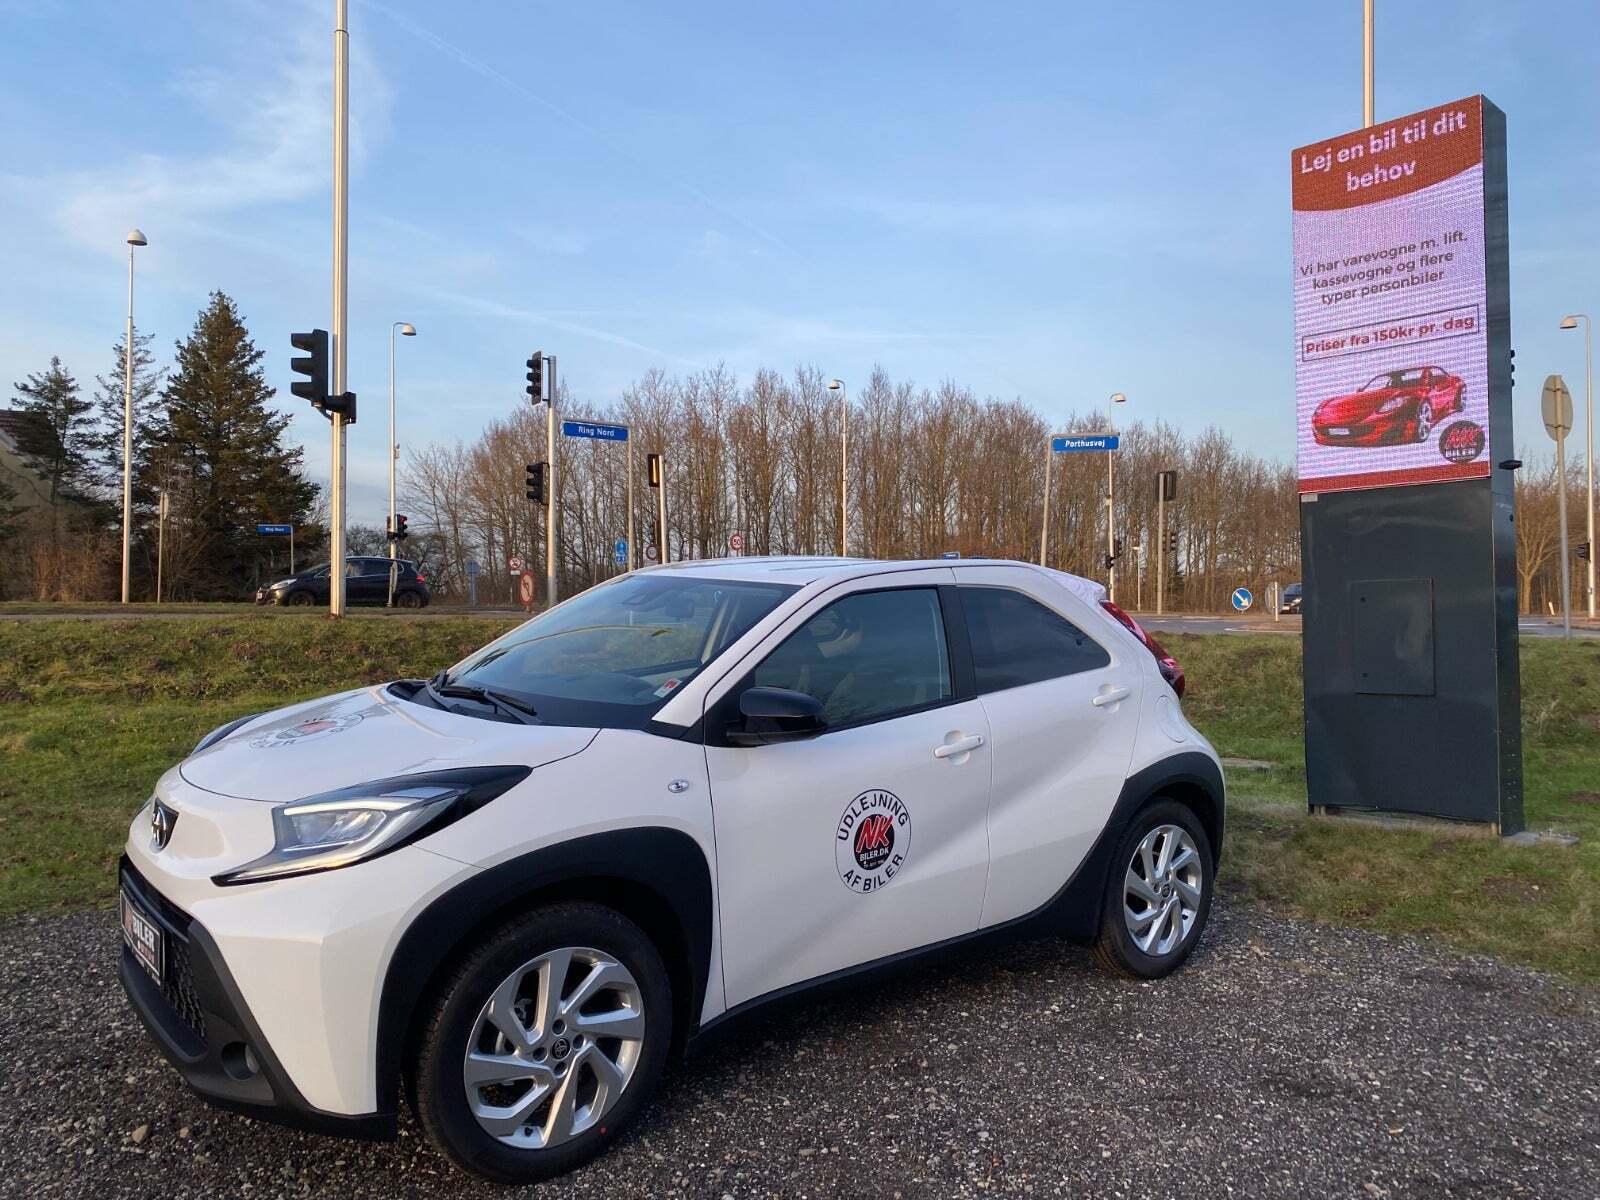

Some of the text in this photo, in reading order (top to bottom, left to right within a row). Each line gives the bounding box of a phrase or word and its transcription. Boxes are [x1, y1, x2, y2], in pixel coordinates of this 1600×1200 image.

[1302, 111, 1467, 173] Lej en bil til dit
[1346, 160, 1416, 192] behov
[1300, 263, 1313, 276] Vi
[1317, 259, 1339, 273] har
[1342, 243, 1416, 267] varevogne
[1420, 238, 1440, 250] m.
[1312, 251, 1454, 290] kassevogne og flere
[1321, 269, 1445, 305] typer personbiler
[1306, 316, 1475, 354] Priser fra 150kr pr. dag
[578, 426, 615, 437] Ring Nord
[838, 793, 908, 841] UDLEJNING
[856, 815, 893, 853] NK
